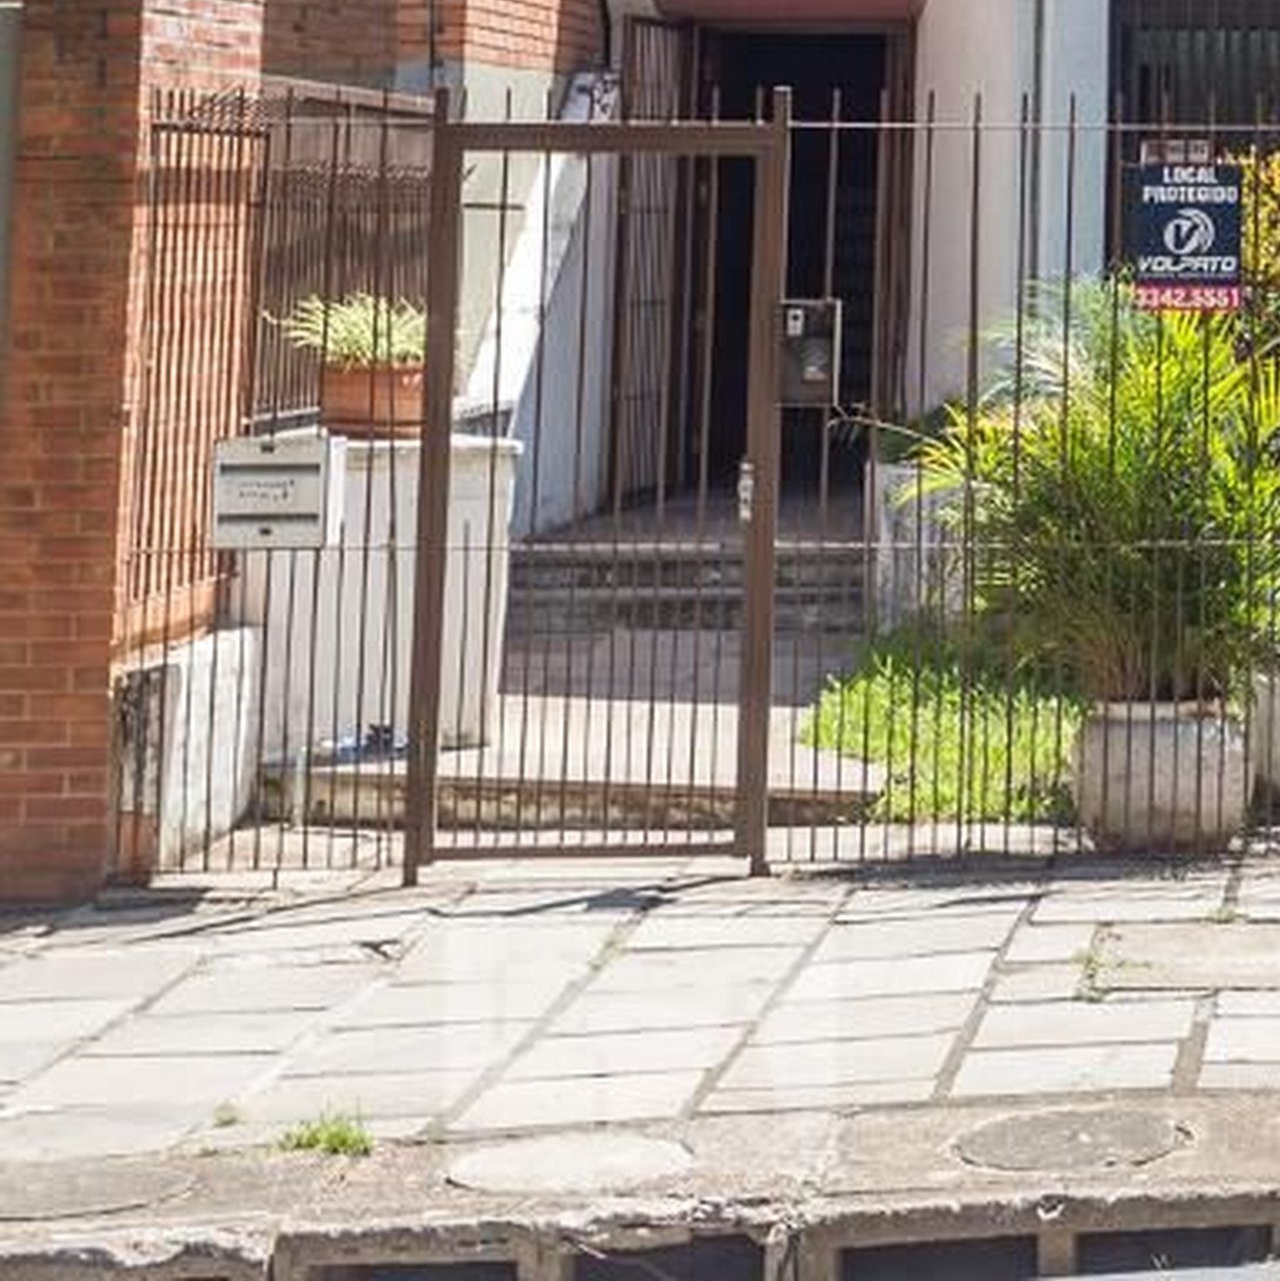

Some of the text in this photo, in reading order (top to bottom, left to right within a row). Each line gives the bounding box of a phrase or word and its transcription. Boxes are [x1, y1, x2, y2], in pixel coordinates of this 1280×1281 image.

[1162, 167, 1218, 184] LOCAL
[1142, 186, 1238, 203] PROTEGIDO
[1138, 256, 1237, 272] VOLPATO
